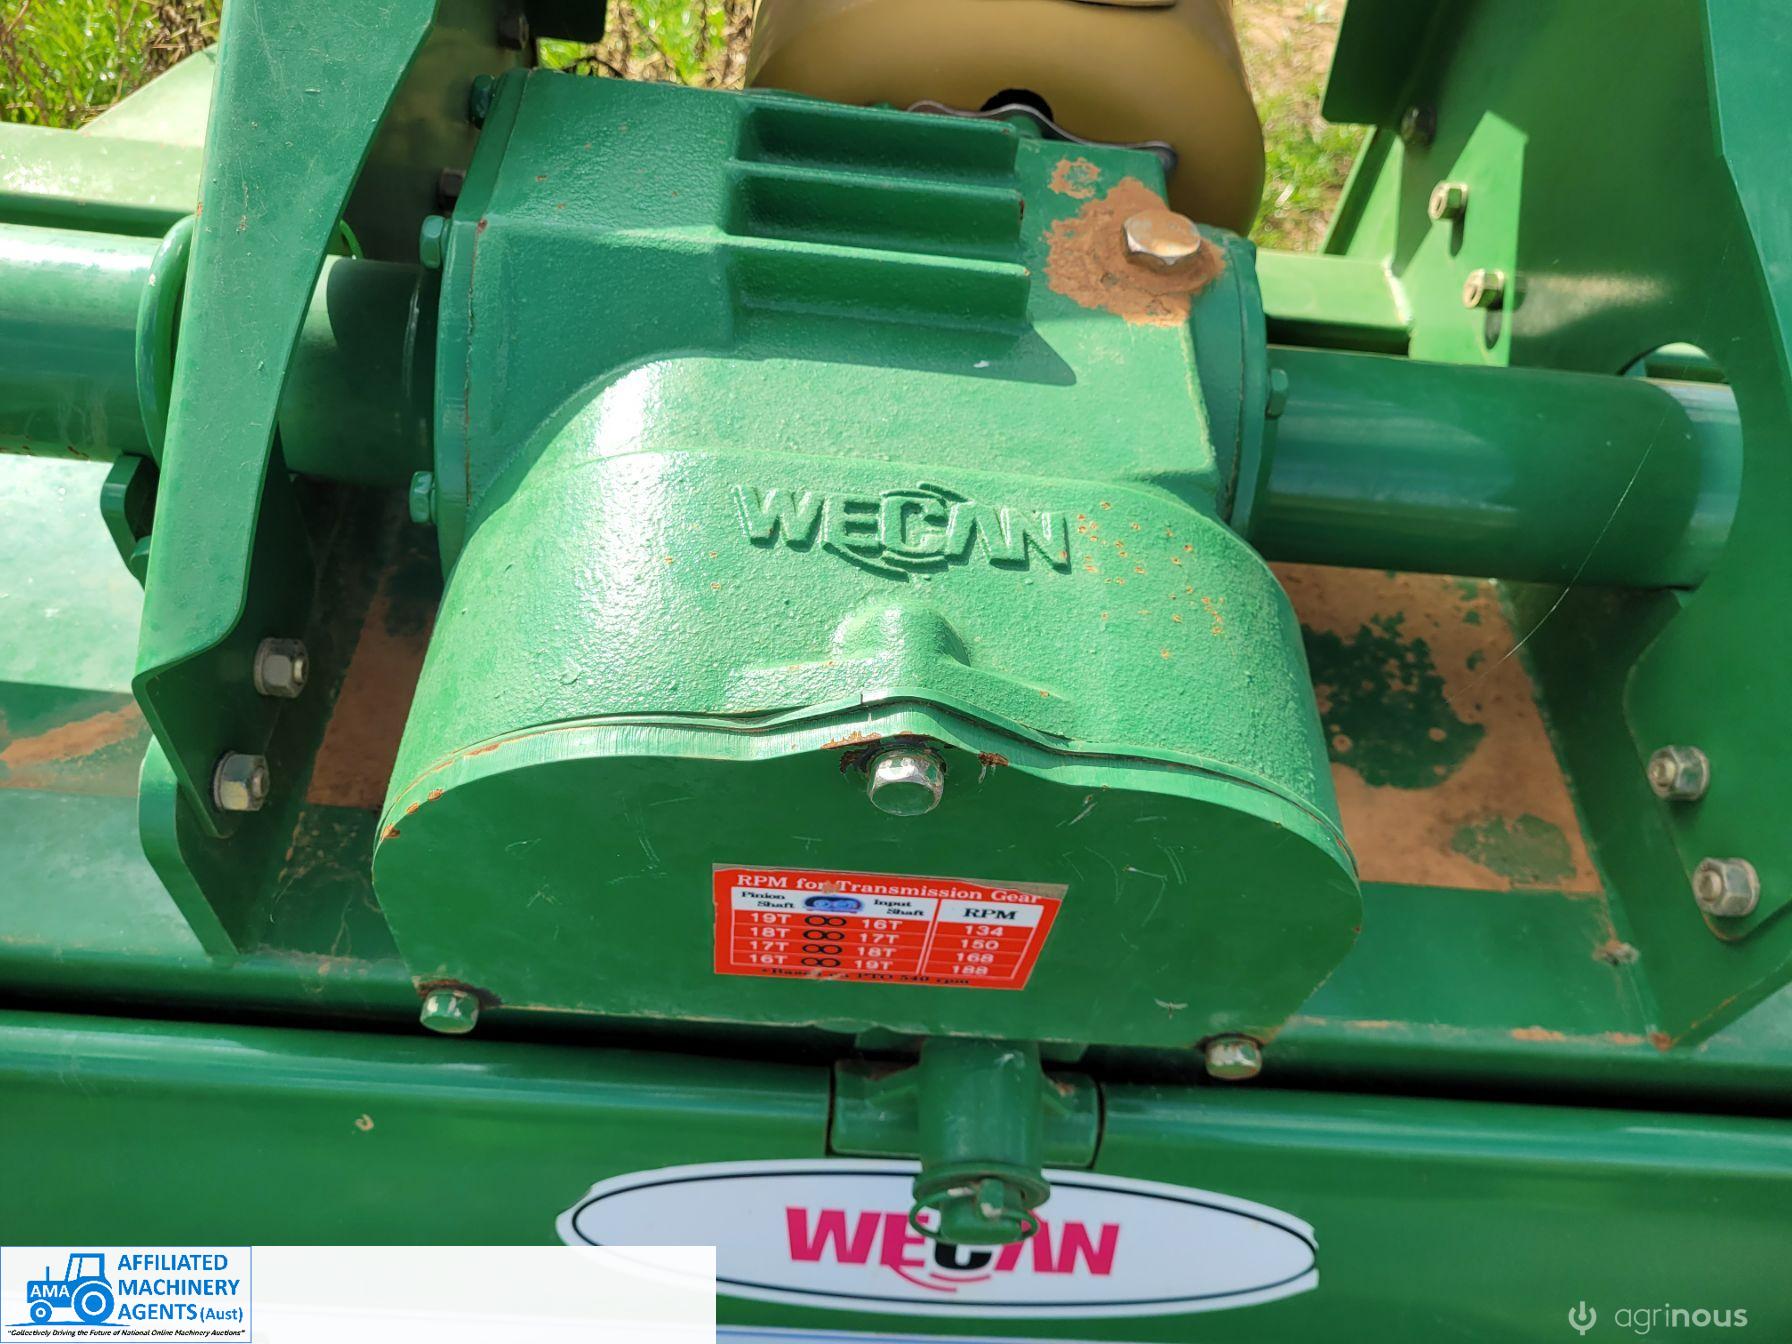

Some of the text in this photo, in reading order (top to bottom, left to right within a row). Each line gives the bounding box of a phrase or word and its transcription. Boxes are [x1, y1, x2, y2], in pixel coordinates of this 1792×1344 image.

[733, 484, 1071, 577] WECAN
[737, 874, 1041, 904] RPM for Transmission Gear
[741, 891, 786, 900] Pinion
[757, 900, 795, 909] Shaft
[874, 899, 912, 908] Input
[887, 908, 924, 917] Shaft
[963, 907, 1019, 920] RPM
[751, 912, 1004, 937] 19T 16T 134
[750, 927, 999, 950] 18T 17T 150
[750, 941, 994, 964] 17T 18T 168
[749, 954, 989, 976] 16T 19T 188
